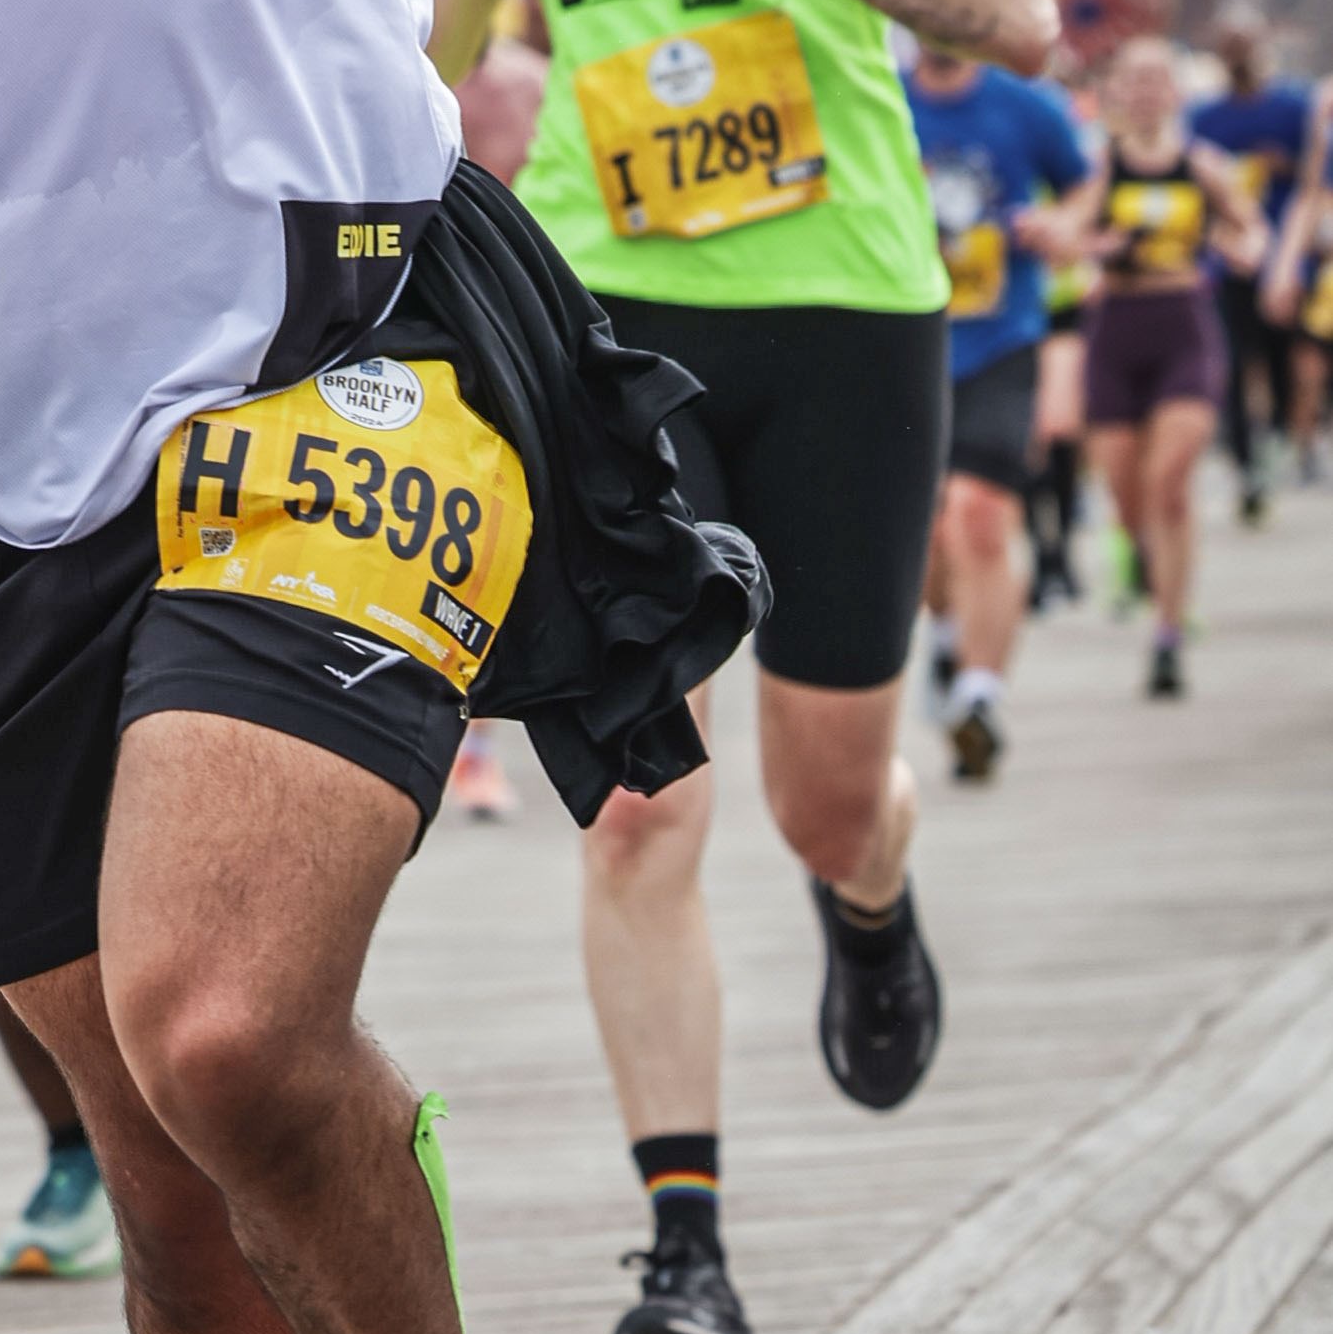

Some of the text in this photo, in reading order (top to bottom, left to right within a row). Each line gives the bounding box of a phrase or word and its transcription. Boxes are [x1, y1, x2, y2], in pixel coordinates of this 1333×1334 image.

[653, 103, 782, 189] 7289
[323, 375, 417, 405] BROOKLYN
[347, 391, 392, 414] HALF
[179, 420, 252, 519] H
[283, 432, 483, 587] 5398
[466, 621, 483, 648] 1
